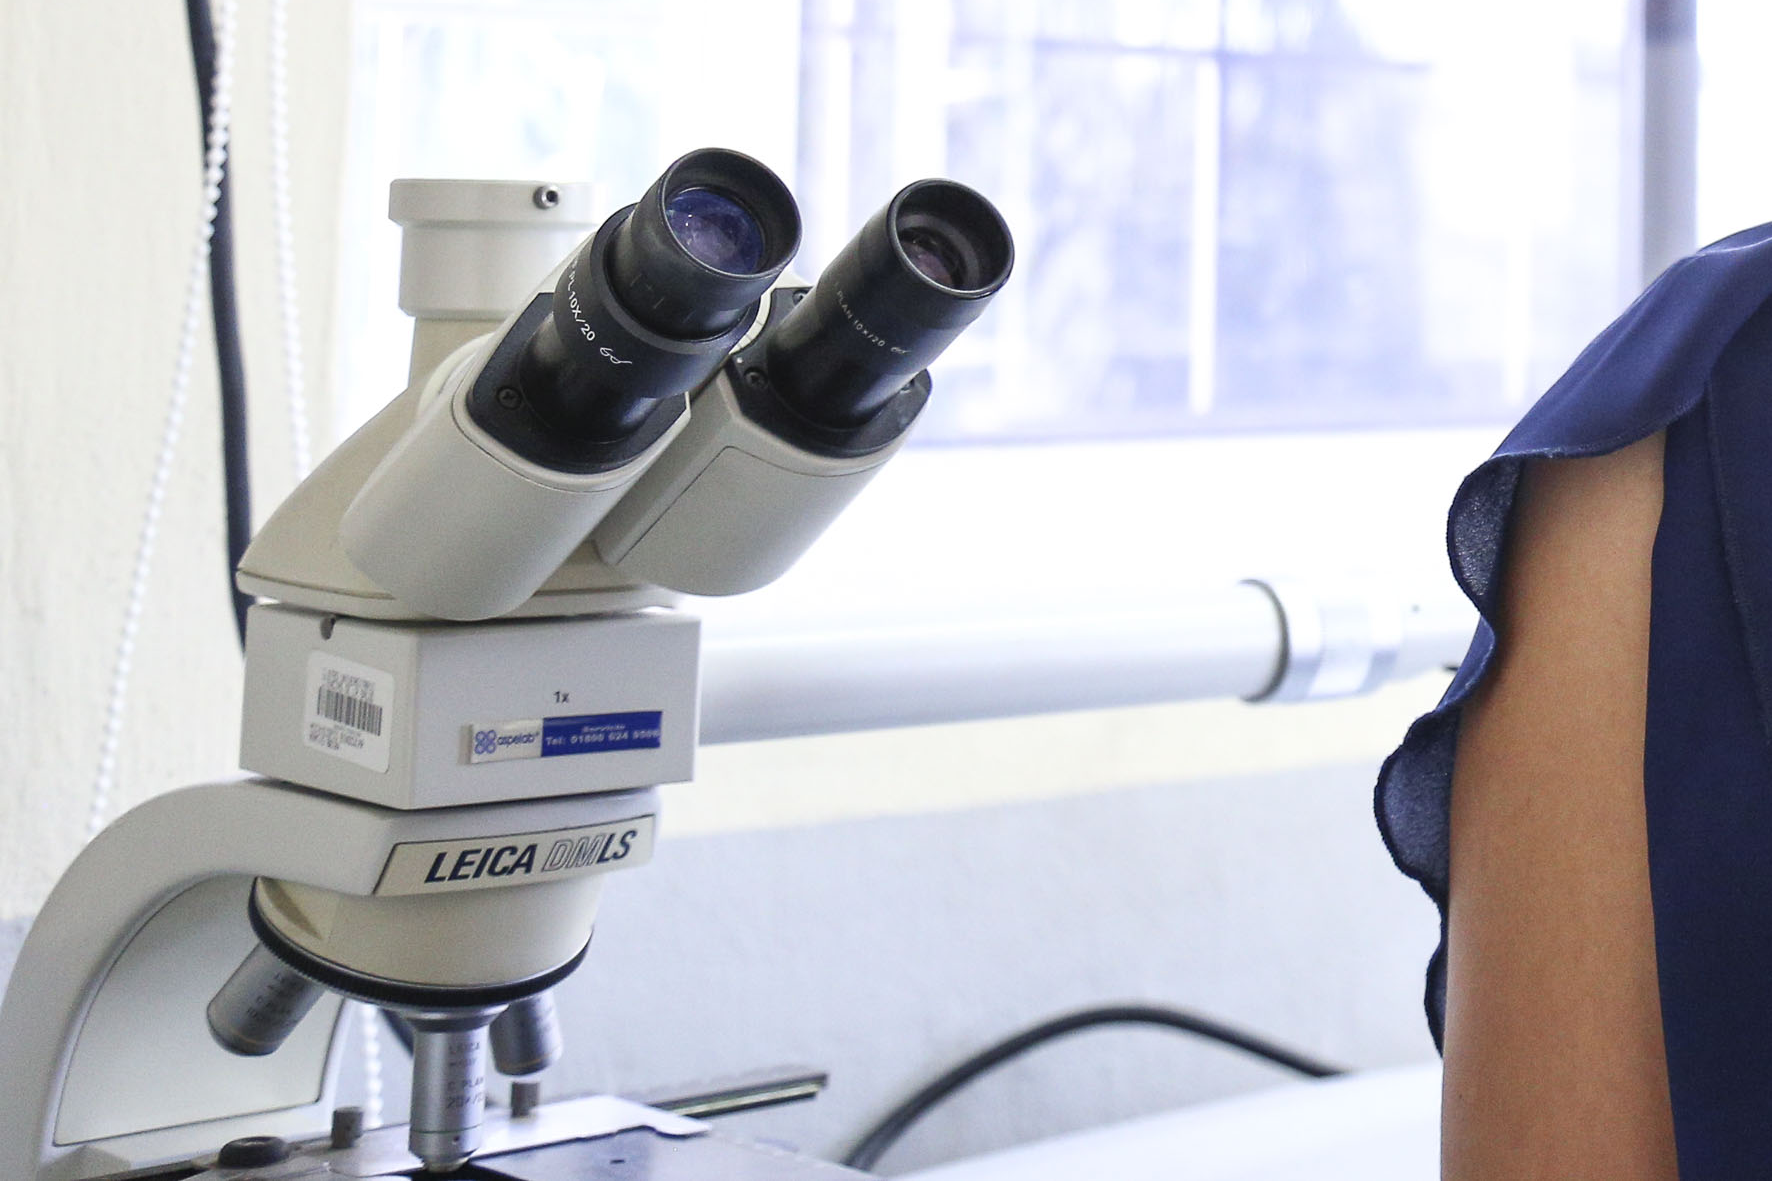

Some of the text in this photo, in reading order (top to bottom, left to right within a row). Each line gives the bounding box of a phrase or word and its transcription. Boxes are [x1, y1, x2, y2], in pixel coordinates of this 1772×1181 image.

[569, 290, 596, 341] 10X/20
[552, 690, 570, 704] 1x
[423, 843, 539, 884] LEICA
